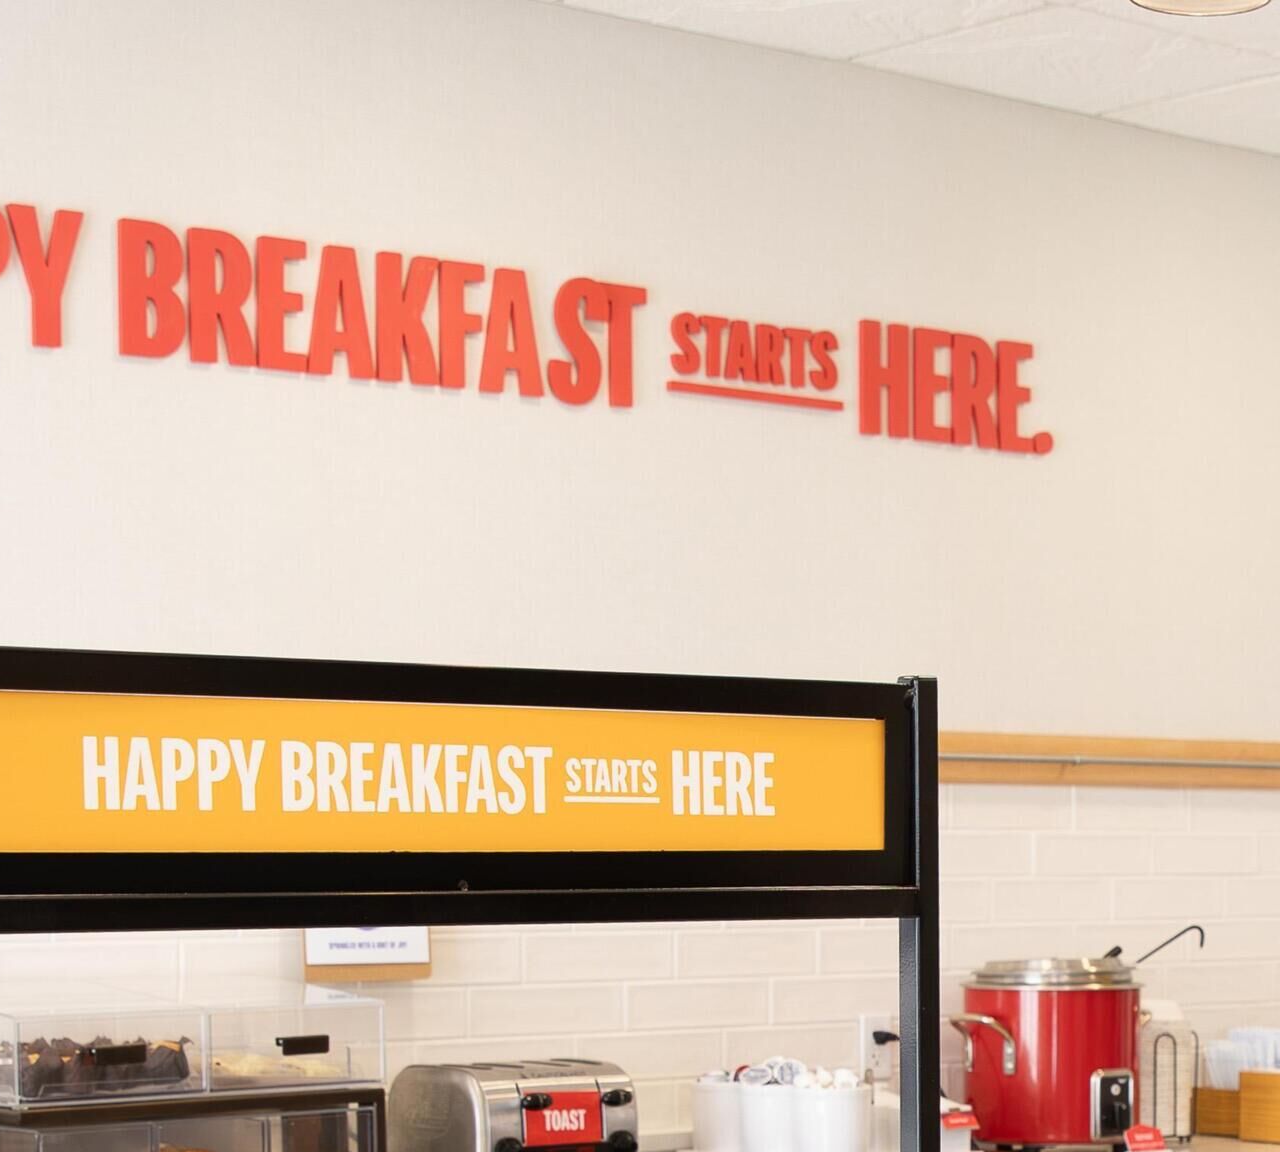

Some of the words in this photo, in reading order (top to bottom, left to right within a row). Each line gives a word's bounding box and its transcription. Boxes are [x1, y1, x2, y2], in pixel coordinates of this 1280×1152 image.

[117, 217, 648, 409] BREAKFAST
[669, 311, 839, 391] STARTS
[858, 319, 1054, 455] HERE.
[82, 735, 266, 812] HAPPY
[280, 740, 553, 815] BREAKFAST
[565, 757, 658, 794] STARTS
[671, 750, 776, 816] HERE
[543, 1108, 586, 1132] TOAST
